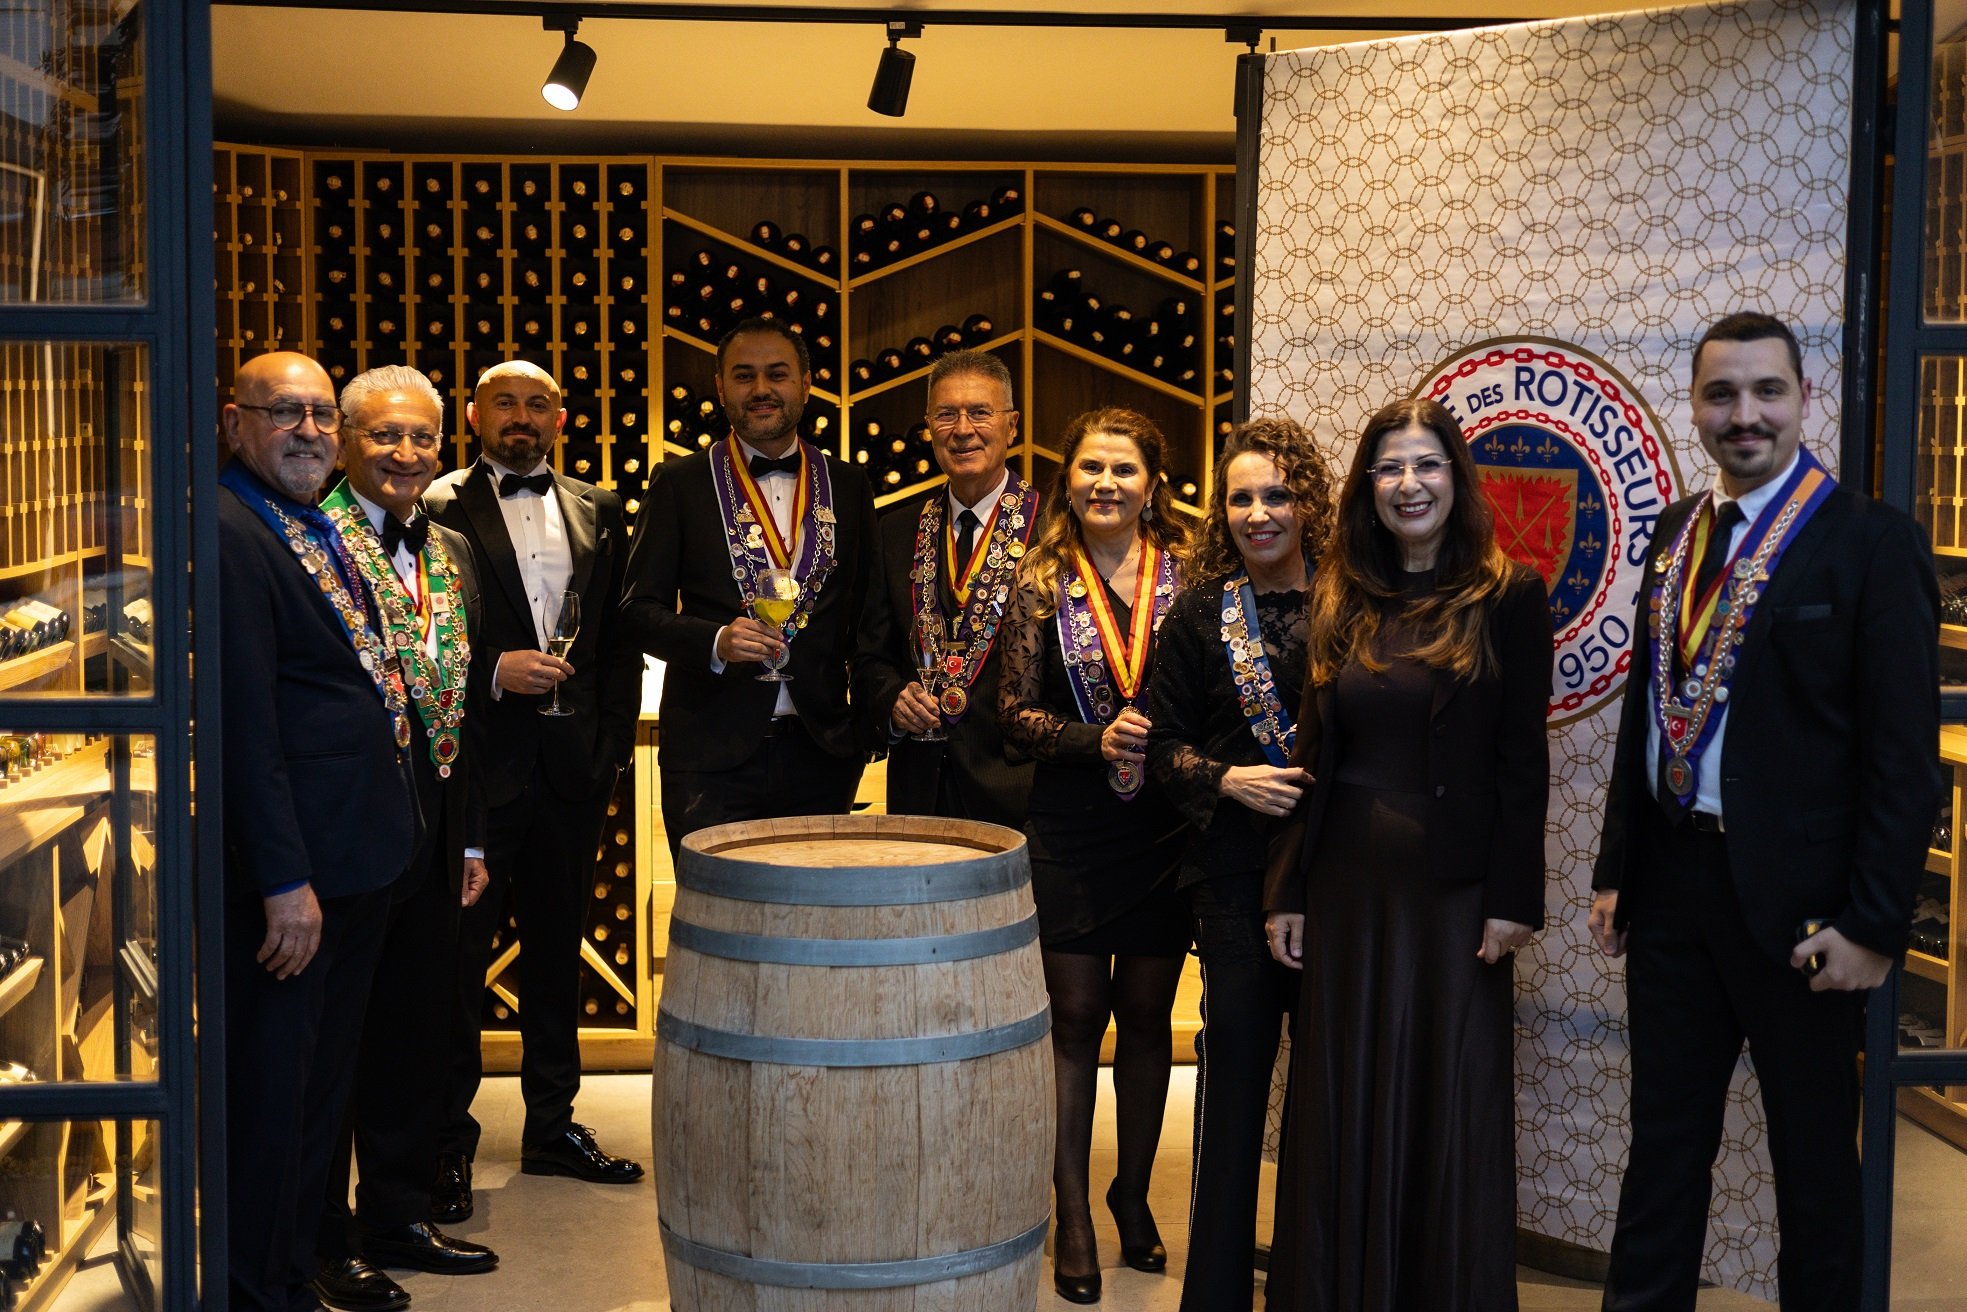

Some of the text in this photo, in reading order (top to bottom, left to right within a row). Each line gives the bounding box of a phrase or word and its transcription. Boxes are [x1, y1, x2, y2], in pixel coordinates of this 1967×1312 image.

[1466, 366, 1660, 567] DES ROTISSEURS
[1552, 615, 1630, 696] 950
